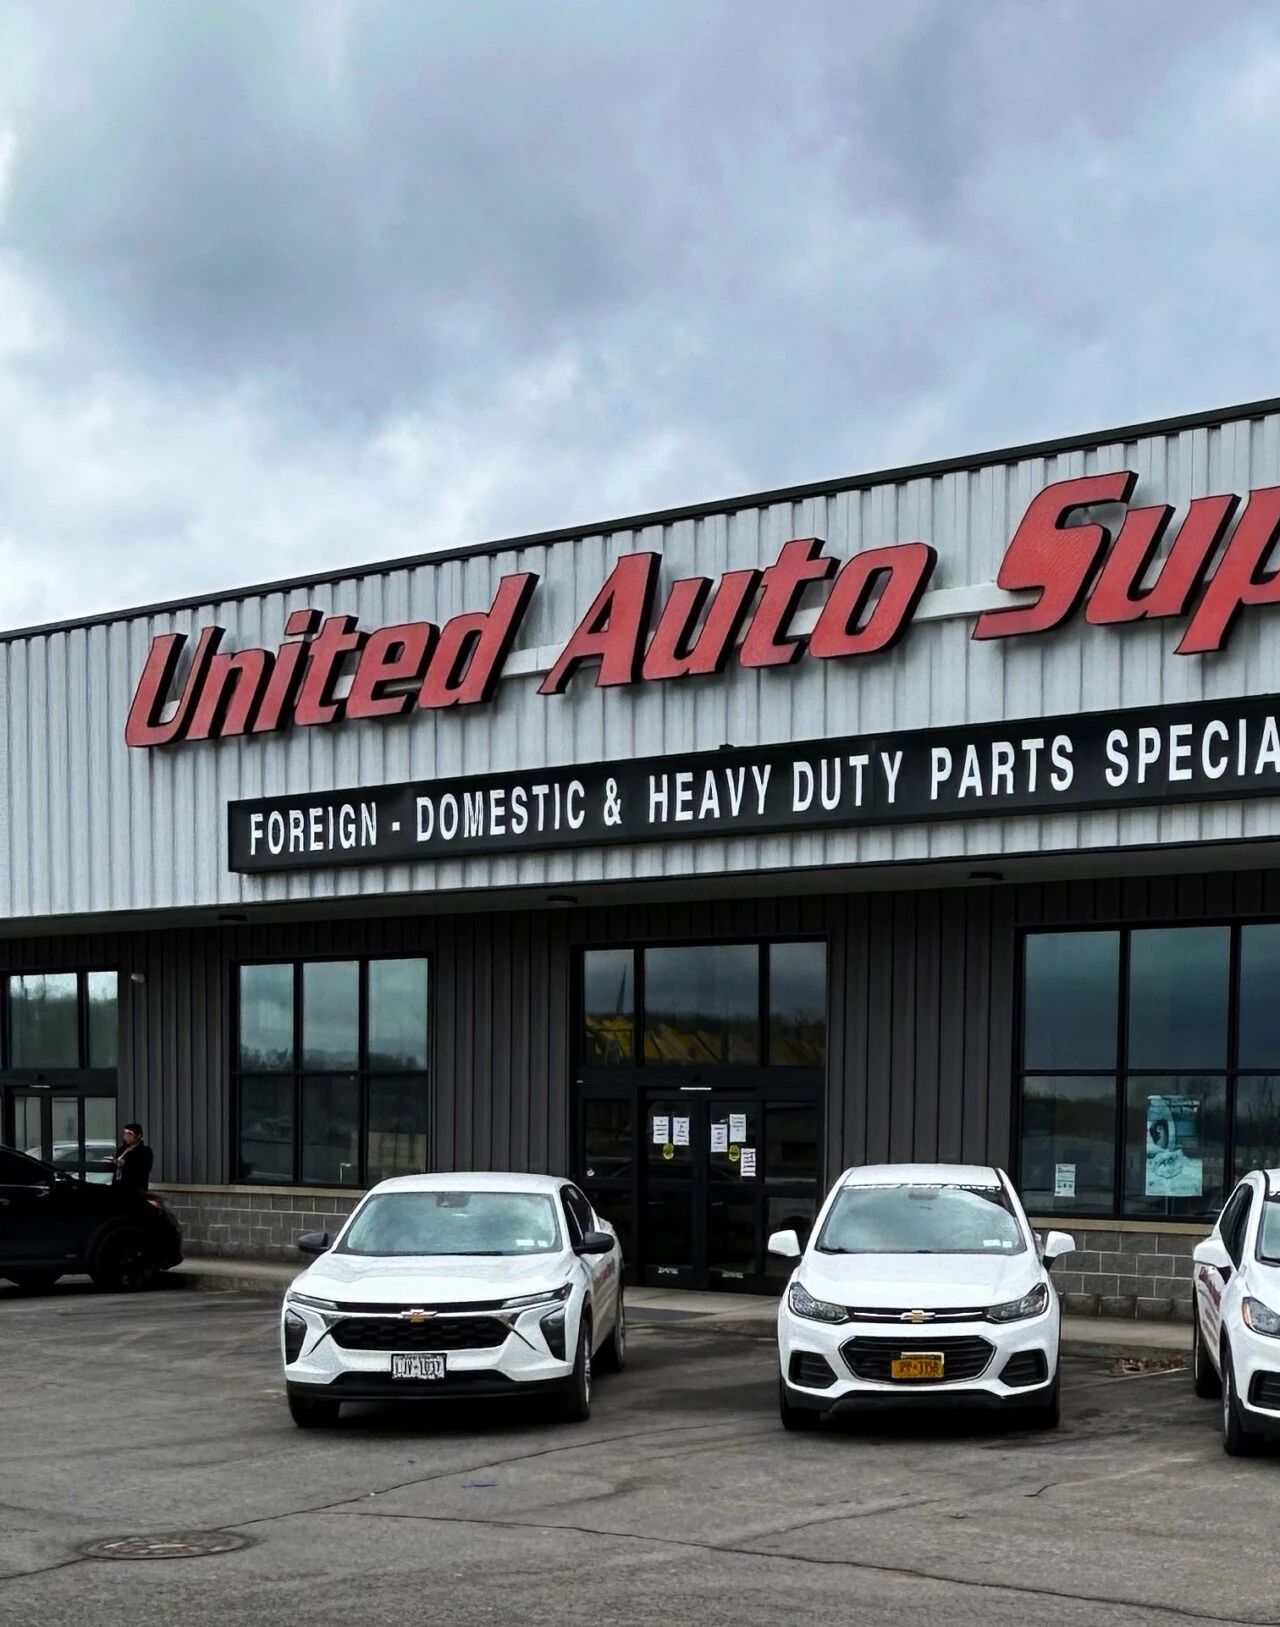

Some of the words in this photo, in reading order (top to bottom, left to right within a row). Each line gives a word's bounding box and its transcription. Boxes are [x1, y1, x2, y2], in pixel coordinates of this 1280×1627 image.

[126, 572, 538, 748] United
[537, 540, 936, 695] Auto
[249, 801, 378, 857] FOREIGN
[416, 780, 586, 843] DOMESTIC
[603, 777, 623, 827] &
[648, 764, 773, 824] HEAVY
[792, 750, 904, 813] DUTY
[930, 734, 1075, 801] PARTS
